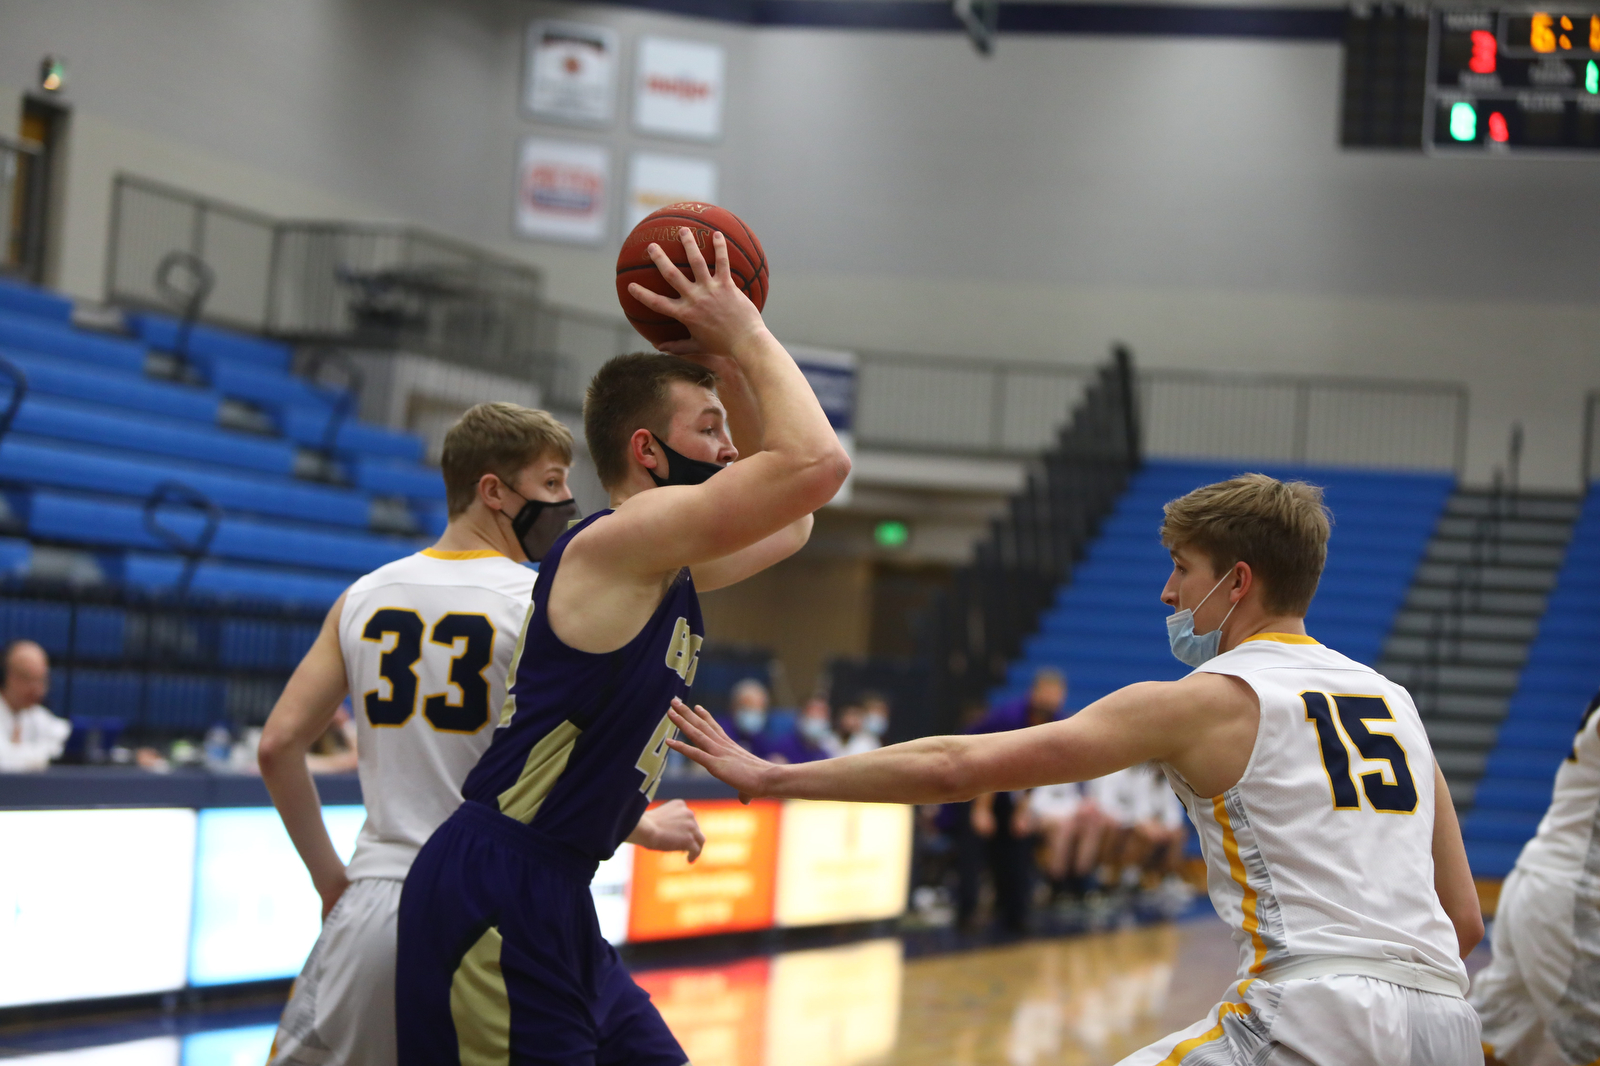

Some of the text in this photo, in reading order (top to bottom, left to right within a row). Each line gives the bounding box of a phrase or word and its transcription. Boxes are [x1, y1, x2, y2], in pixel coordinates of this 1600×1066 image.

[1469, 29, 1498, 74] 3
[360, 606, 497, 735] 33
[634, 695, 682, 803] 4
[1297, 689, 1420, 815] 15
